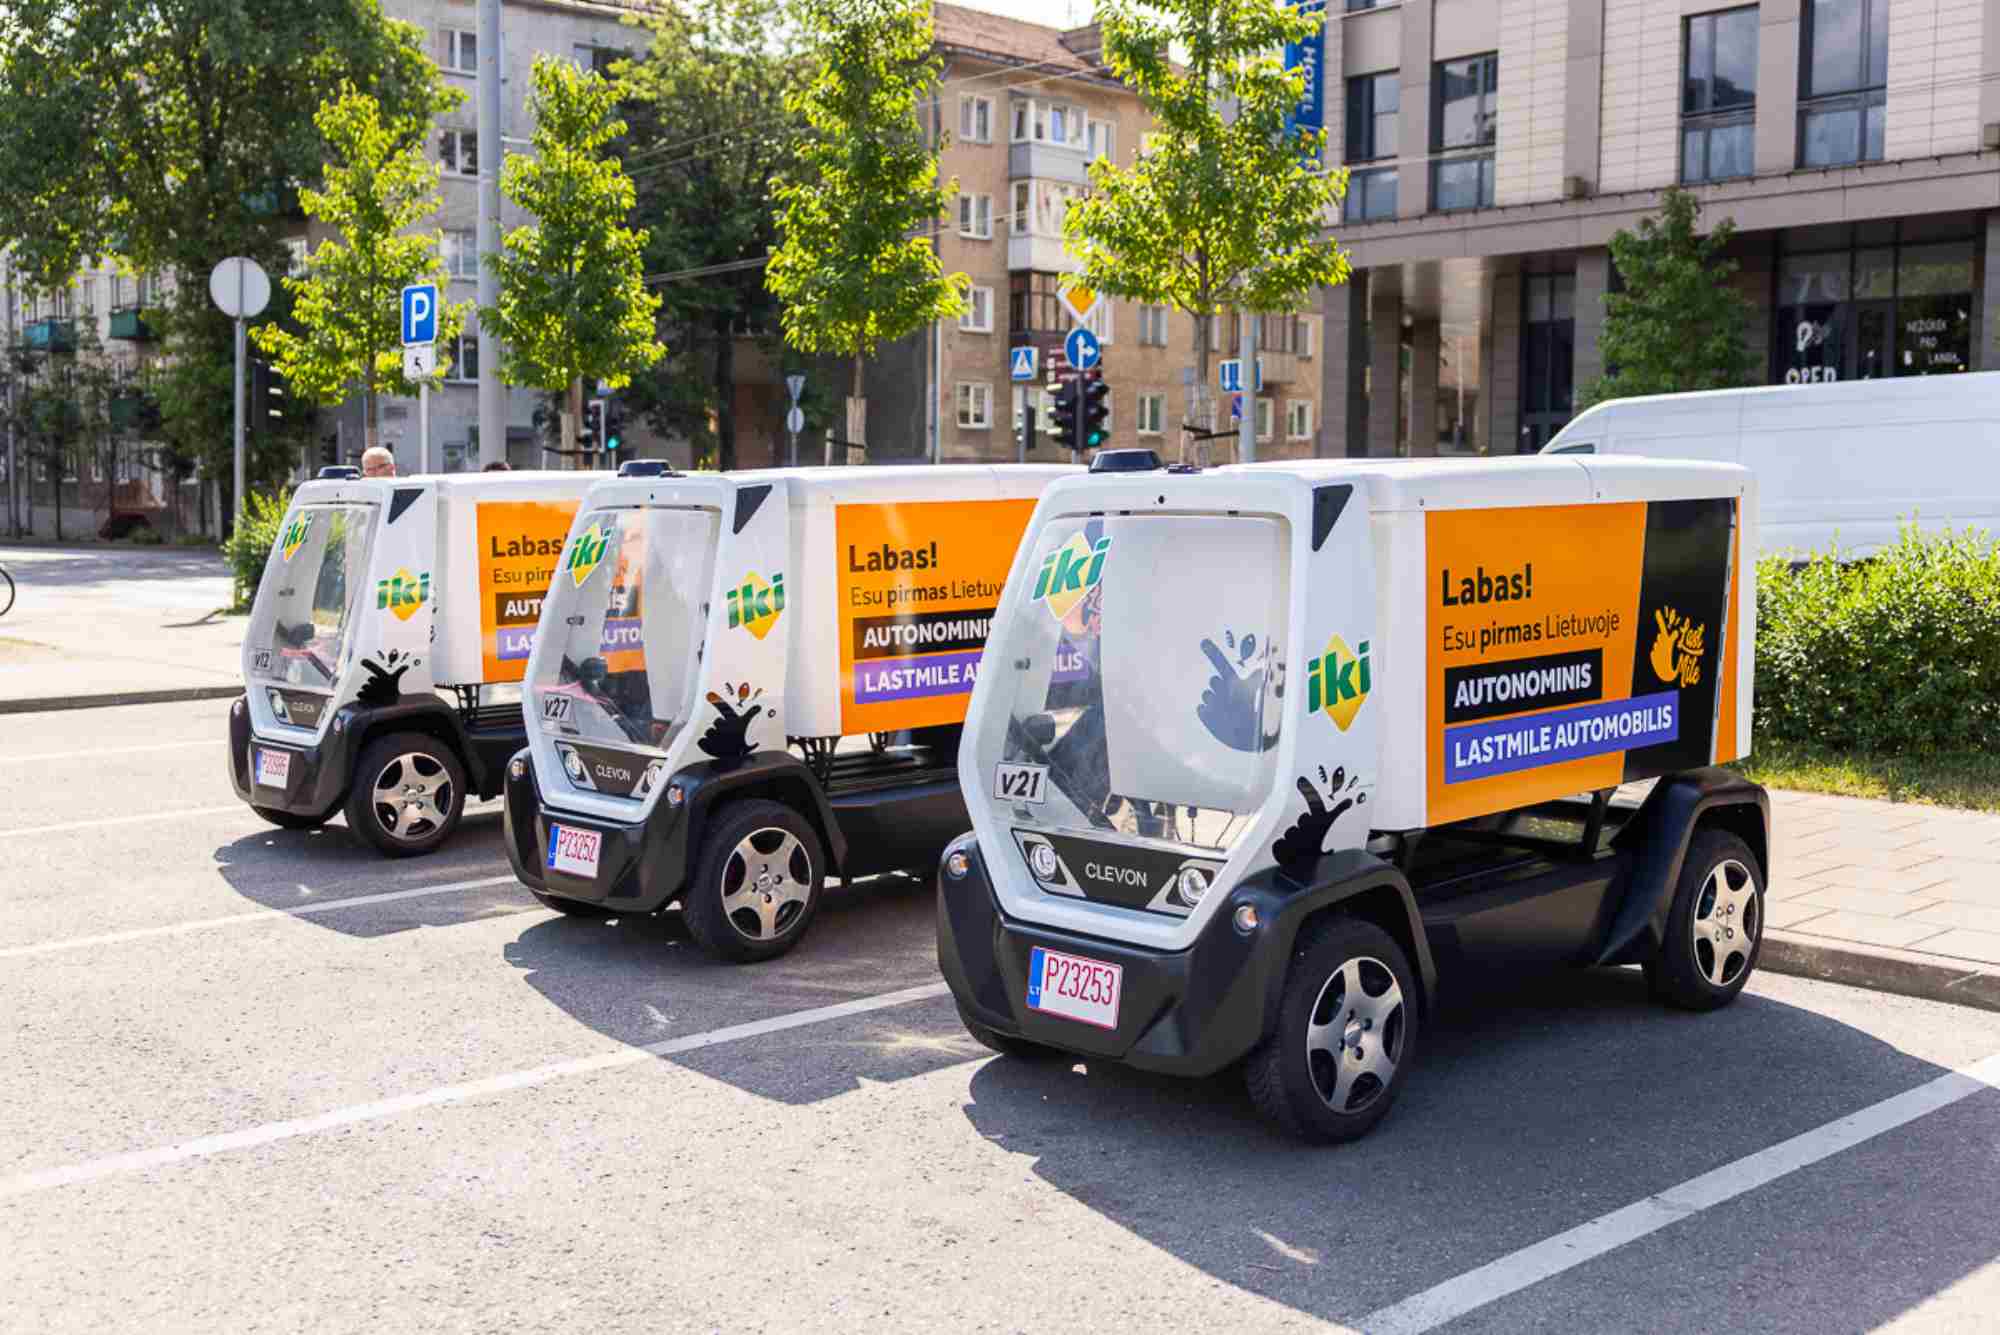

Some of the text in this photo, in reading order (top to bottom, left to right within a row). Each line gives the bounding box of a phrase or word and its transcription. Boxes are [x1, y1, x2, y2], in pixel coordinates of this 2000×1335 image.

[1302, 46, 1317, 113] HOTEL
[410, 291, 430, 338] P
[281, 516, 311, 550] iki
[567, 527, 611, 569] iki
[494, 567, 522, 584] Esu
[850, 542, 937, 573] Labas!
[1033, 538, 1110, 599] iki
[378, 572, 429, 608] iki
[727, 573, 785, 629] iki
[851, 586, 882, 606] Esu
[887, 580, 947, 607] pirmas
[1443, 564, 1532, 606] Labas!
[1443, 609, 1620, 653] Esu pirmas Lietuvoje
[1677, 618, 1705, 656] Last
[863, 668, 960, 693] LASTMILE
[1308, 640, 1372, 713] iki
[1453, 663, 1592, 708] AUTONOMINIS
[1455, 705, 1673, 768] LASTMILE AUTOMOBILIS
[596, 764, 631, 781] CLEVON
[1085, 862, 1147, 887] CLEVON
[1044, 956, 1114, 1006] P23253
